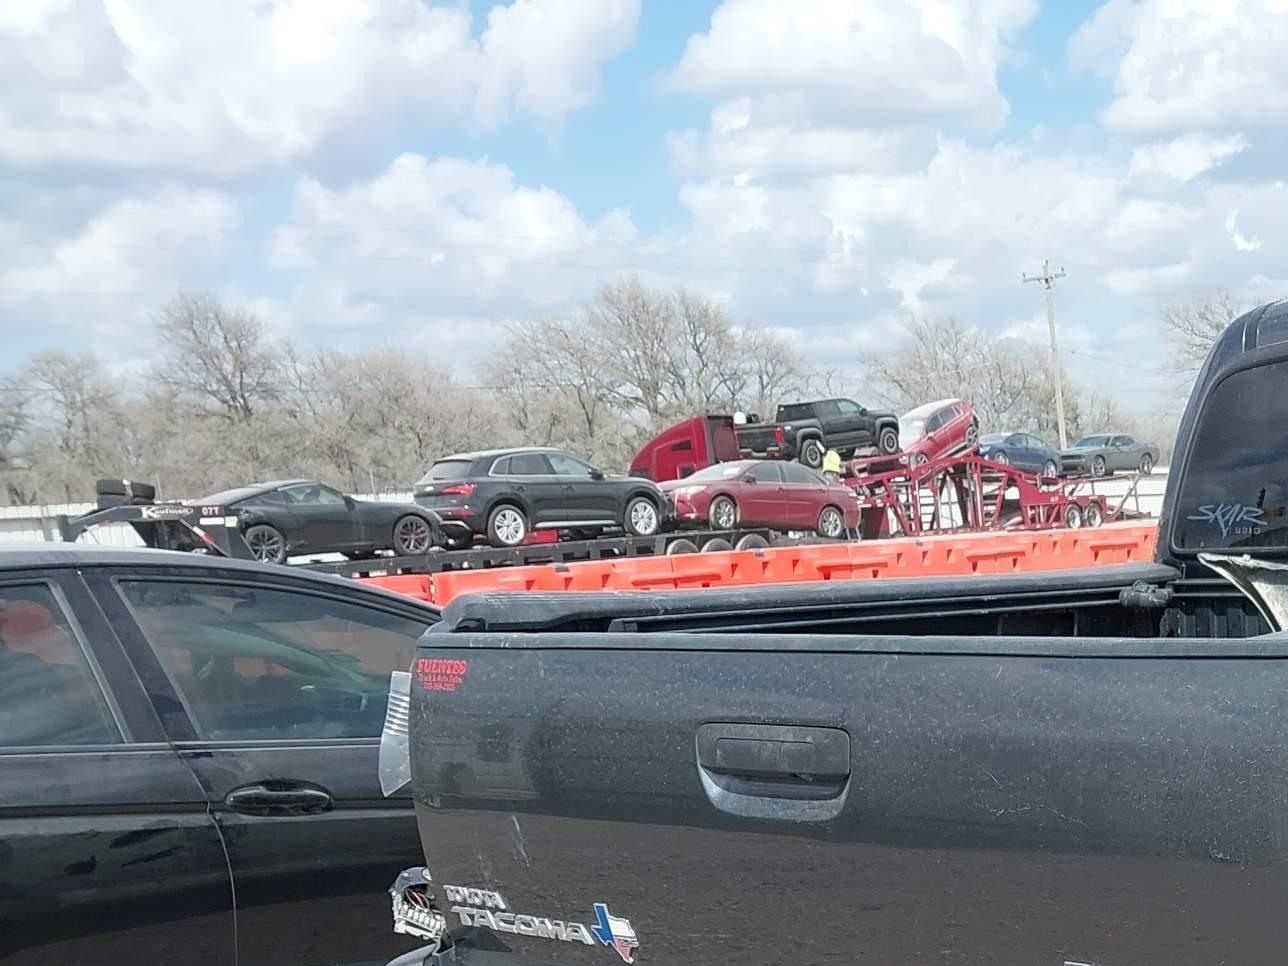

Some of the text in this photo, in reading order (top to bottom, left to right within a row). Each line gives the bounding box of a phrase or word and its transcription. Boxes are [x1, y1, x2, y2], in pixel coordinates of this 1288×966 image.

[416, 658, 466, 674] FUENTES
[443, 885, 507, 909] TOYOTA
[451, 905, 595, 945] TACOMA
